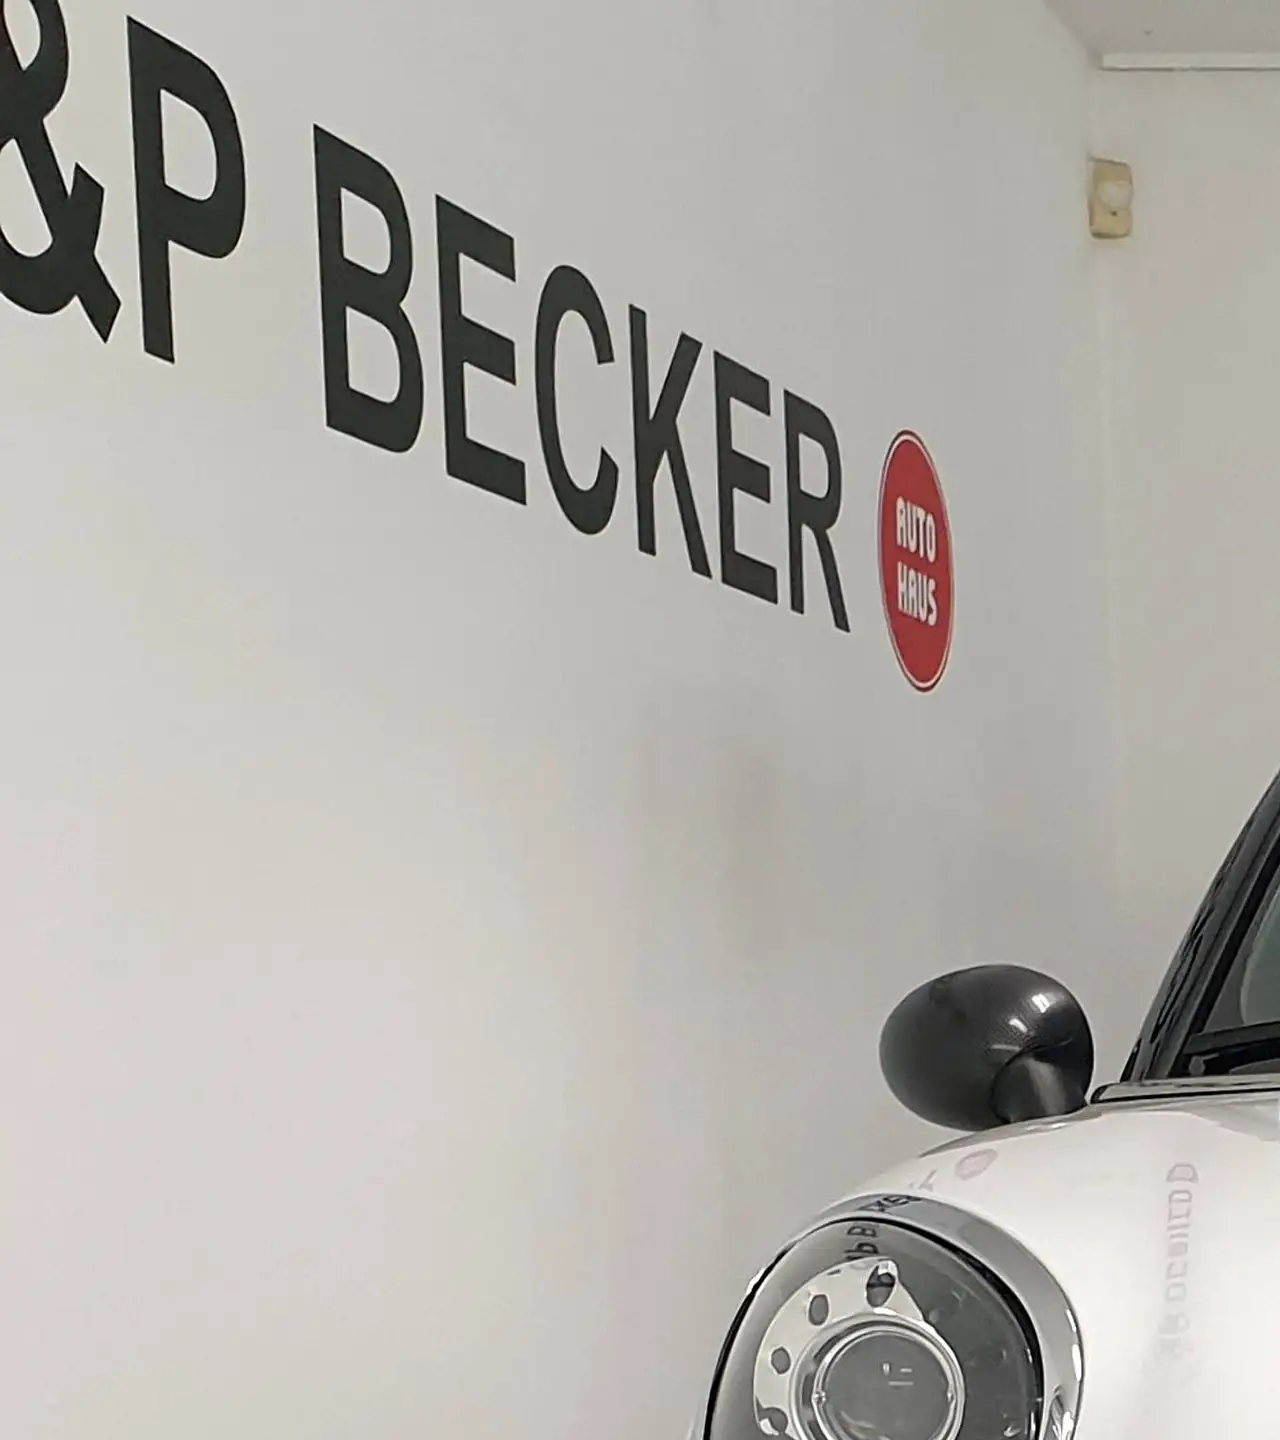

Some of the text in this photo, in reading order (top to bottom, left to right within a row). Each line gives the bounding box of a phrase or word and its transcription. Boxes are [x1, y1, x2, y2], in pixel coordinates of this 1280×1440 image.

[313, 123, 850, 633] BECKER
[896, 496, 936, 563] AUTO
[897, 561, 937, 626] HAUS
